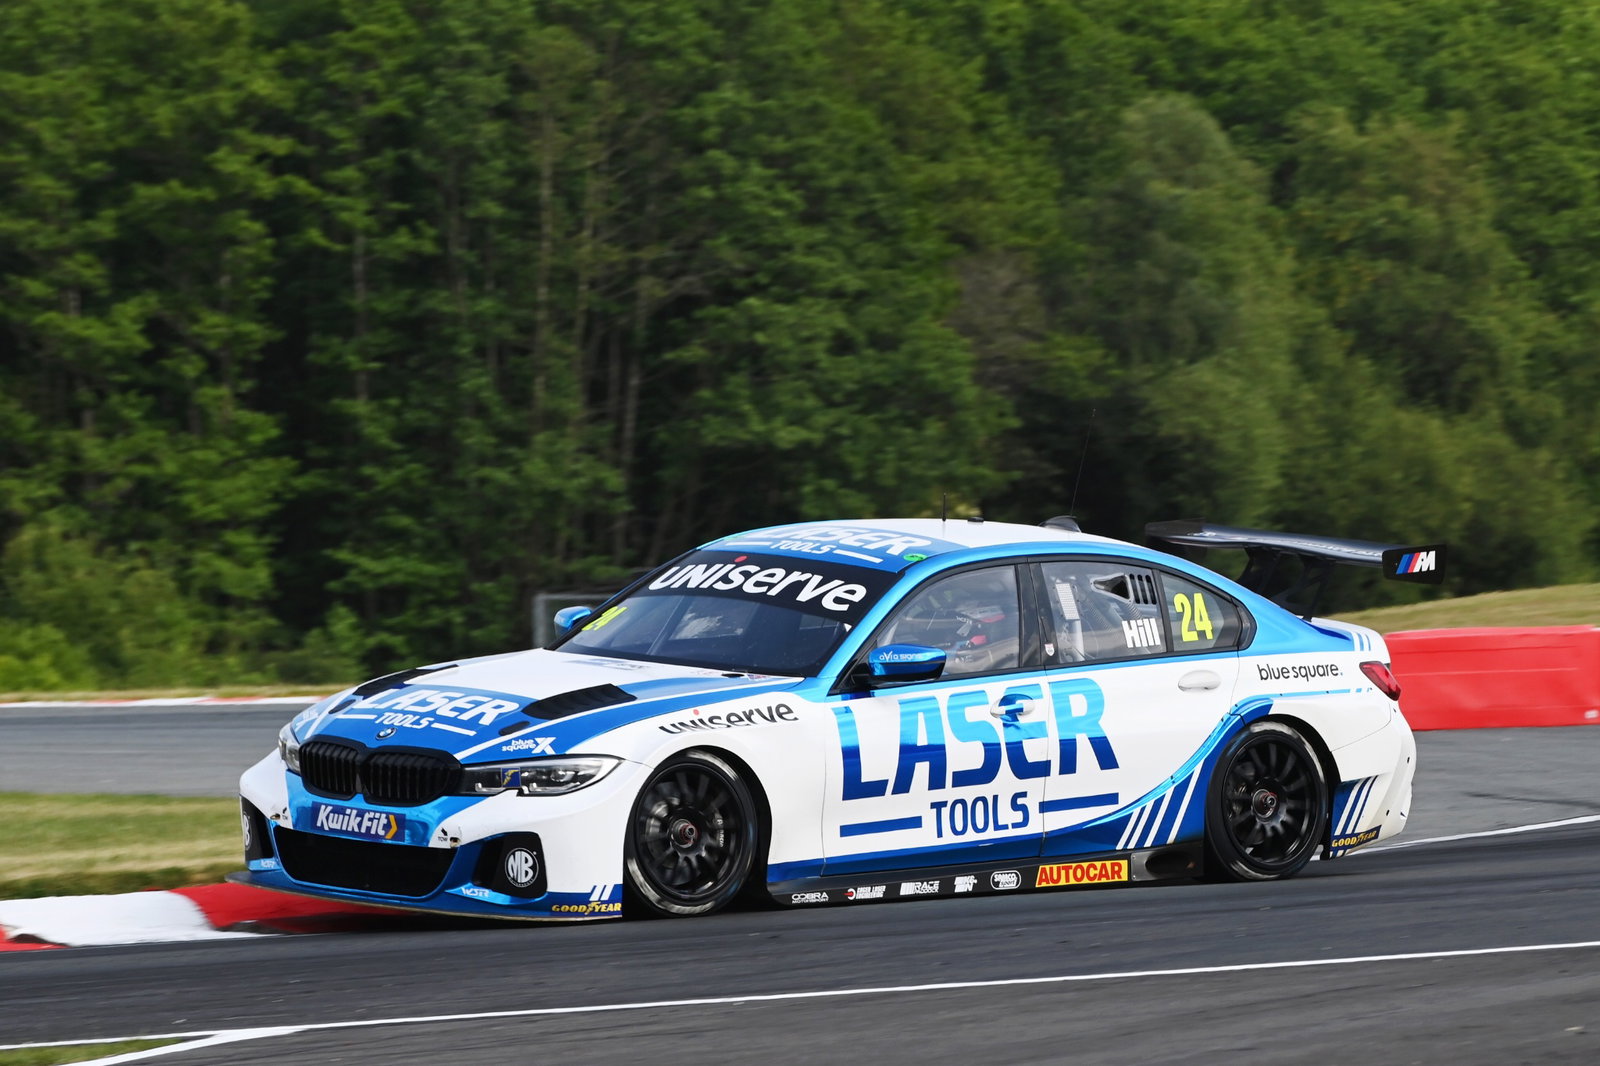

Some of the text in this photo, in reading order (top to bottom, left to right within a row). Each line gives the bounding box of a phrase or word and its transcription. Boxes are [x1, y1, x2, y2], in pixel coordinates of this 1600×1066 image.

[744, 527, 932, 556] LASER
[770, 540, 836, 554] TOOLS
[1173, 593, 1213, 642] 24
[1122, 618, 1160, 648] Hill
[1257, 664, 1290, 681] blue
[352, 688, 519, 726] LASER
[375, 711, 434, 729] TOOLS
[831, 678, 1120, 801] LASER
[930, 791, 1029, 838] TOOLS
[1331, 831, 1377, 848] GOODYEAR
[1037, 861, 1123, 886] AUTOCAR
[791, 891, 829, 901] COBRA
[914, 881, 940, 891] RACE
[551, 902, 622, 914] GOODYEAR
